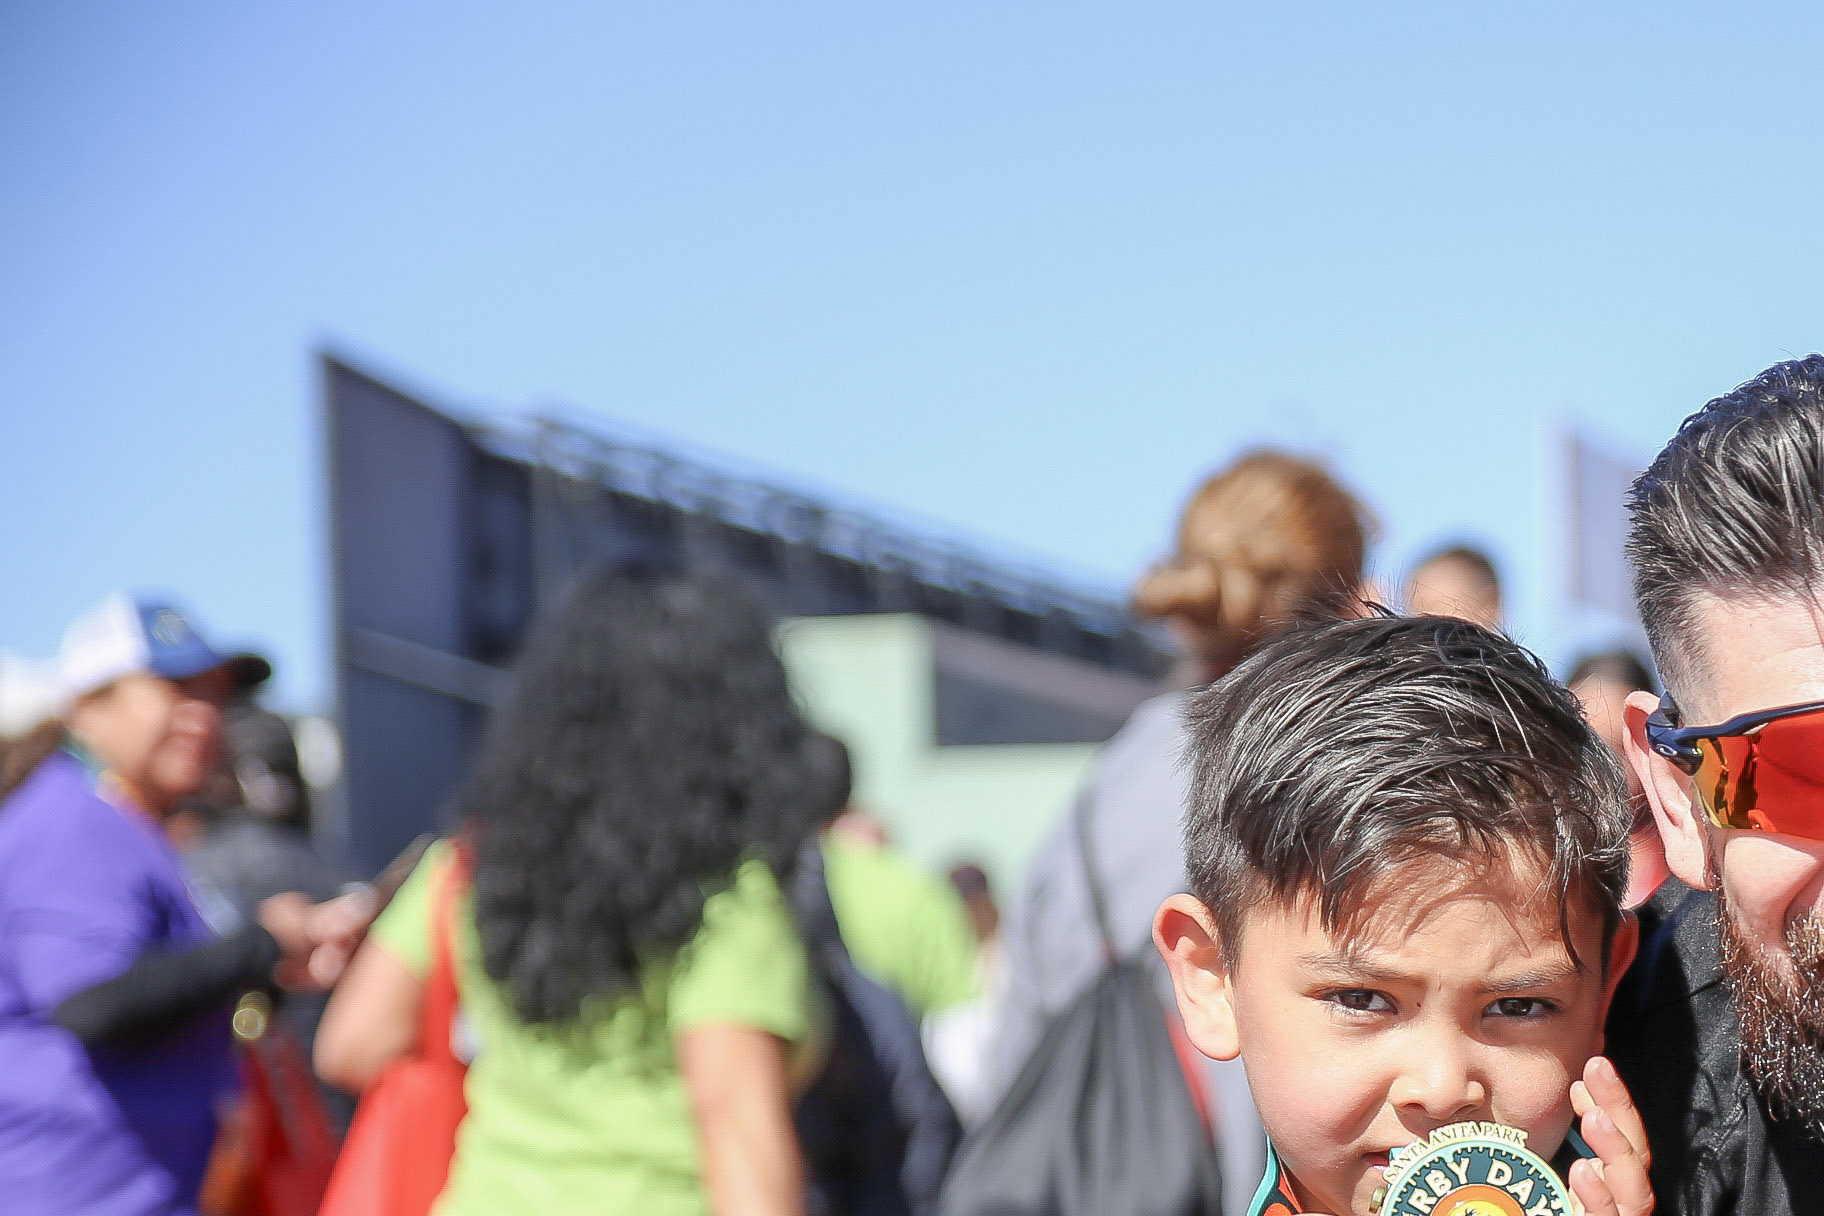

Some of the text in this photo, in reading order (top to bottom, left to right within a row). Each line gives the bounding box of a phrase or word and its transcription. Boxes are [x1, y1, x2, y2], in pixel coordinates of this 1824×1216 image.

[1384, 1121, 1526, 1182] SANTA ANITA PARK
